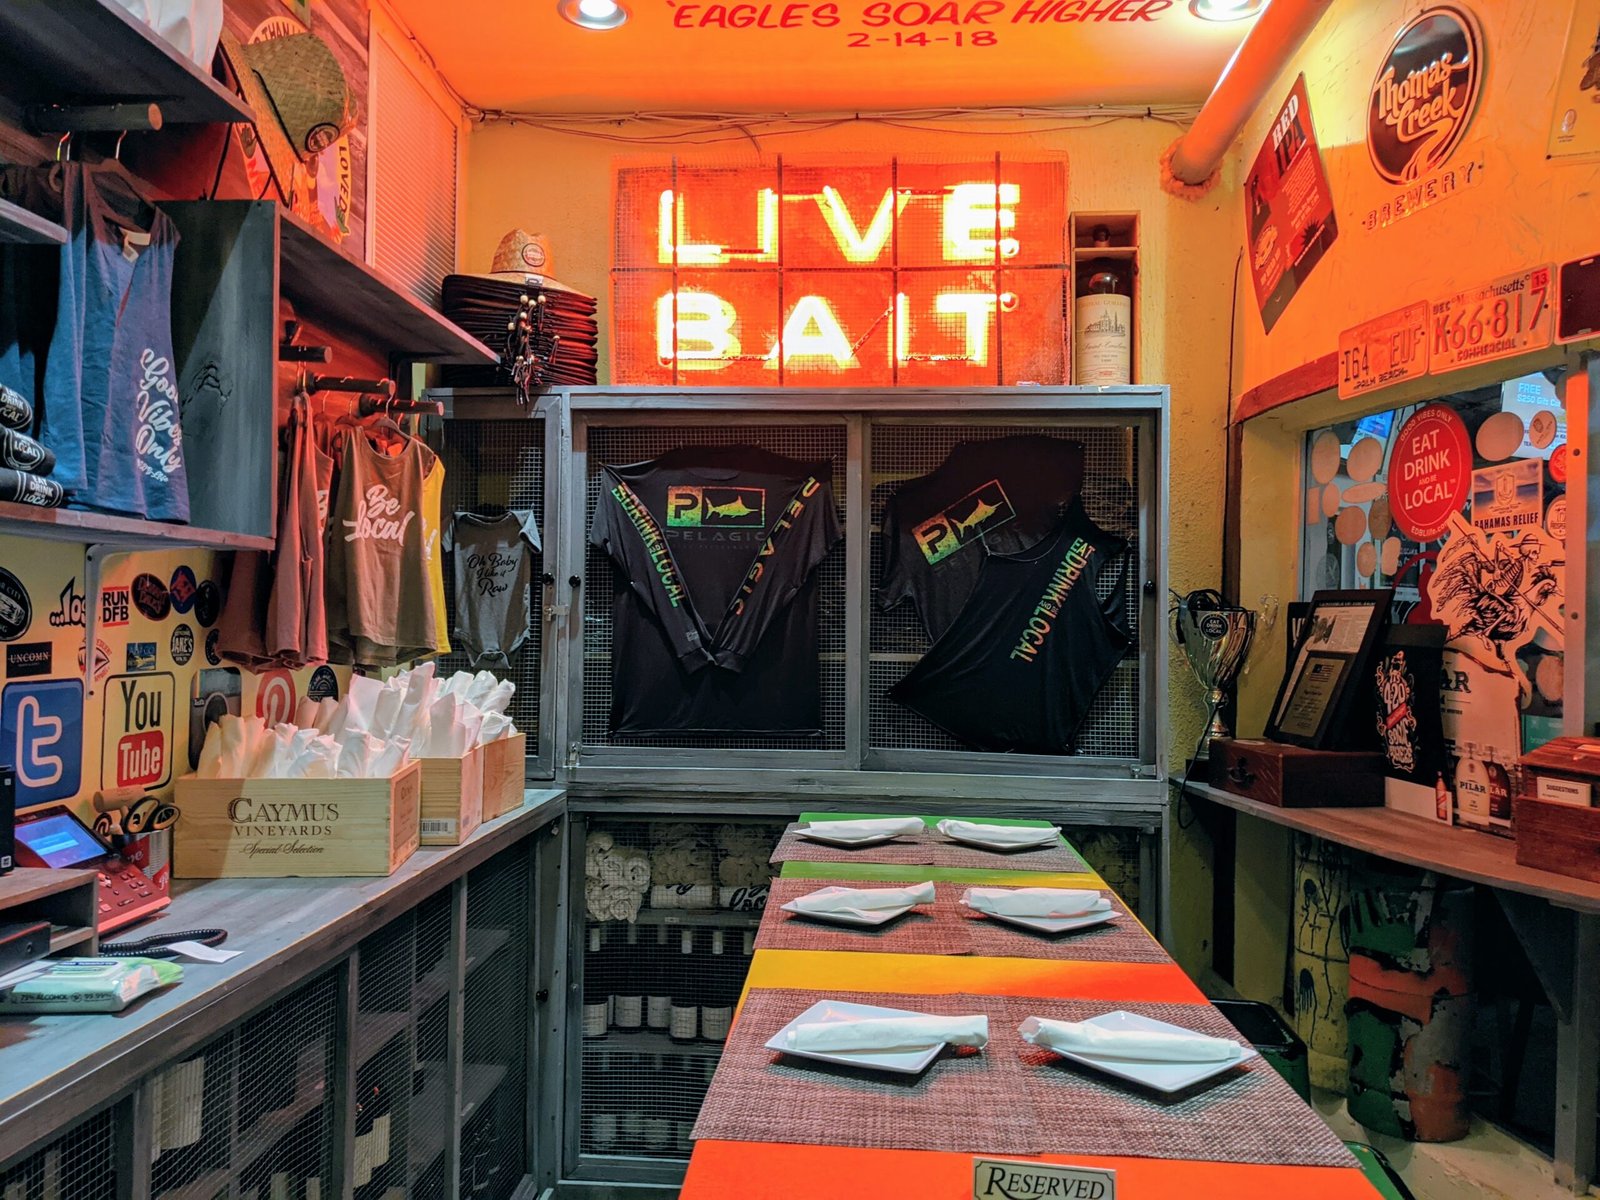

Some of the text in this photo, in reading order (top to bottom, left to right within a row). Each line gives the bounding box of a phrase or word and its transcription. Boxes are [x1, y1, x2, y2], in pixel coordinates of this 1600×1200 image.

[862, 0, 1002, 27] SOAR
[1011, 0, 1174, 24] HIGHER
[262, 21, 288, 41] THAN
[847, 31, 998, 48] 2-14-18
[1374, 52, 1469, 120] Thomas
[1271, 94, 1300, 149] RED
[1386, 79, 1464, 143] Creek
[1274, 114, 1307, 179] IPA
[1367, 161, 1475, 231] BREWERY
[657, 182, 1021, 264] LIVE
[1533, 272, 1549, 287] 13
[655, 290, 1015, 369] BAIT
[1457, 340, 1516, 361] COMMERCIAL
[1355, 367, 1405, 389] PALM BEACH
[1519, 382, 1541, 395] FREE
[137, 391, 182, 446] Vibes
[1400, 409, 1452, 441] GOOD VIBES ONLY
[14, 440, 37, 458] LOCAL
[136, 424, 182, 473] Only
[1412, 429, 1440, 456] EAT
[1404, 448, 1451, 481] DRINK
[30, 481, 54, 496] DRINK
[1419, 474, 1437, 485] AND BE
[23, 493, 49, 506] LOCAL
[366, 484, 401, 518] Be
[1405, 481, 1452, 511] LOCAL
[1474, 512, 1538, 529] BAHAMAS RELIEF
[665, 530, 766, 541] PELAGIC
[1069, 537, 1096, 560] EAT
[467, 552, 518, 572] Oh Baby
[478, 577, 508, 597] Raw
[651, 549, 686, 609] LOCAL
[1041, 550, 1088, 608] DRINK
[103, 590, 129, 606] RUN
[103, 606, 129, 622] DFB
[1009, 606, 1057, 662] LOCAL
[10, 652, 49, 664] UNCOMN
[121, 680, 161, 732] You
[120, 740, 160, 781] Tube
[1459, 781, 1486, 794] PILAR
[1546, 784, 1579, 795] SUGGESTIONS
[227, 797, 340, 823] CAYMUS
[234, 825, 332, 836] VINEYARDS
[239, 838, 325, 859] Special Selection
[36, 993, 67, 1001] ALCOHOL
[984, 1166, 1105, 1200] RESERVED
